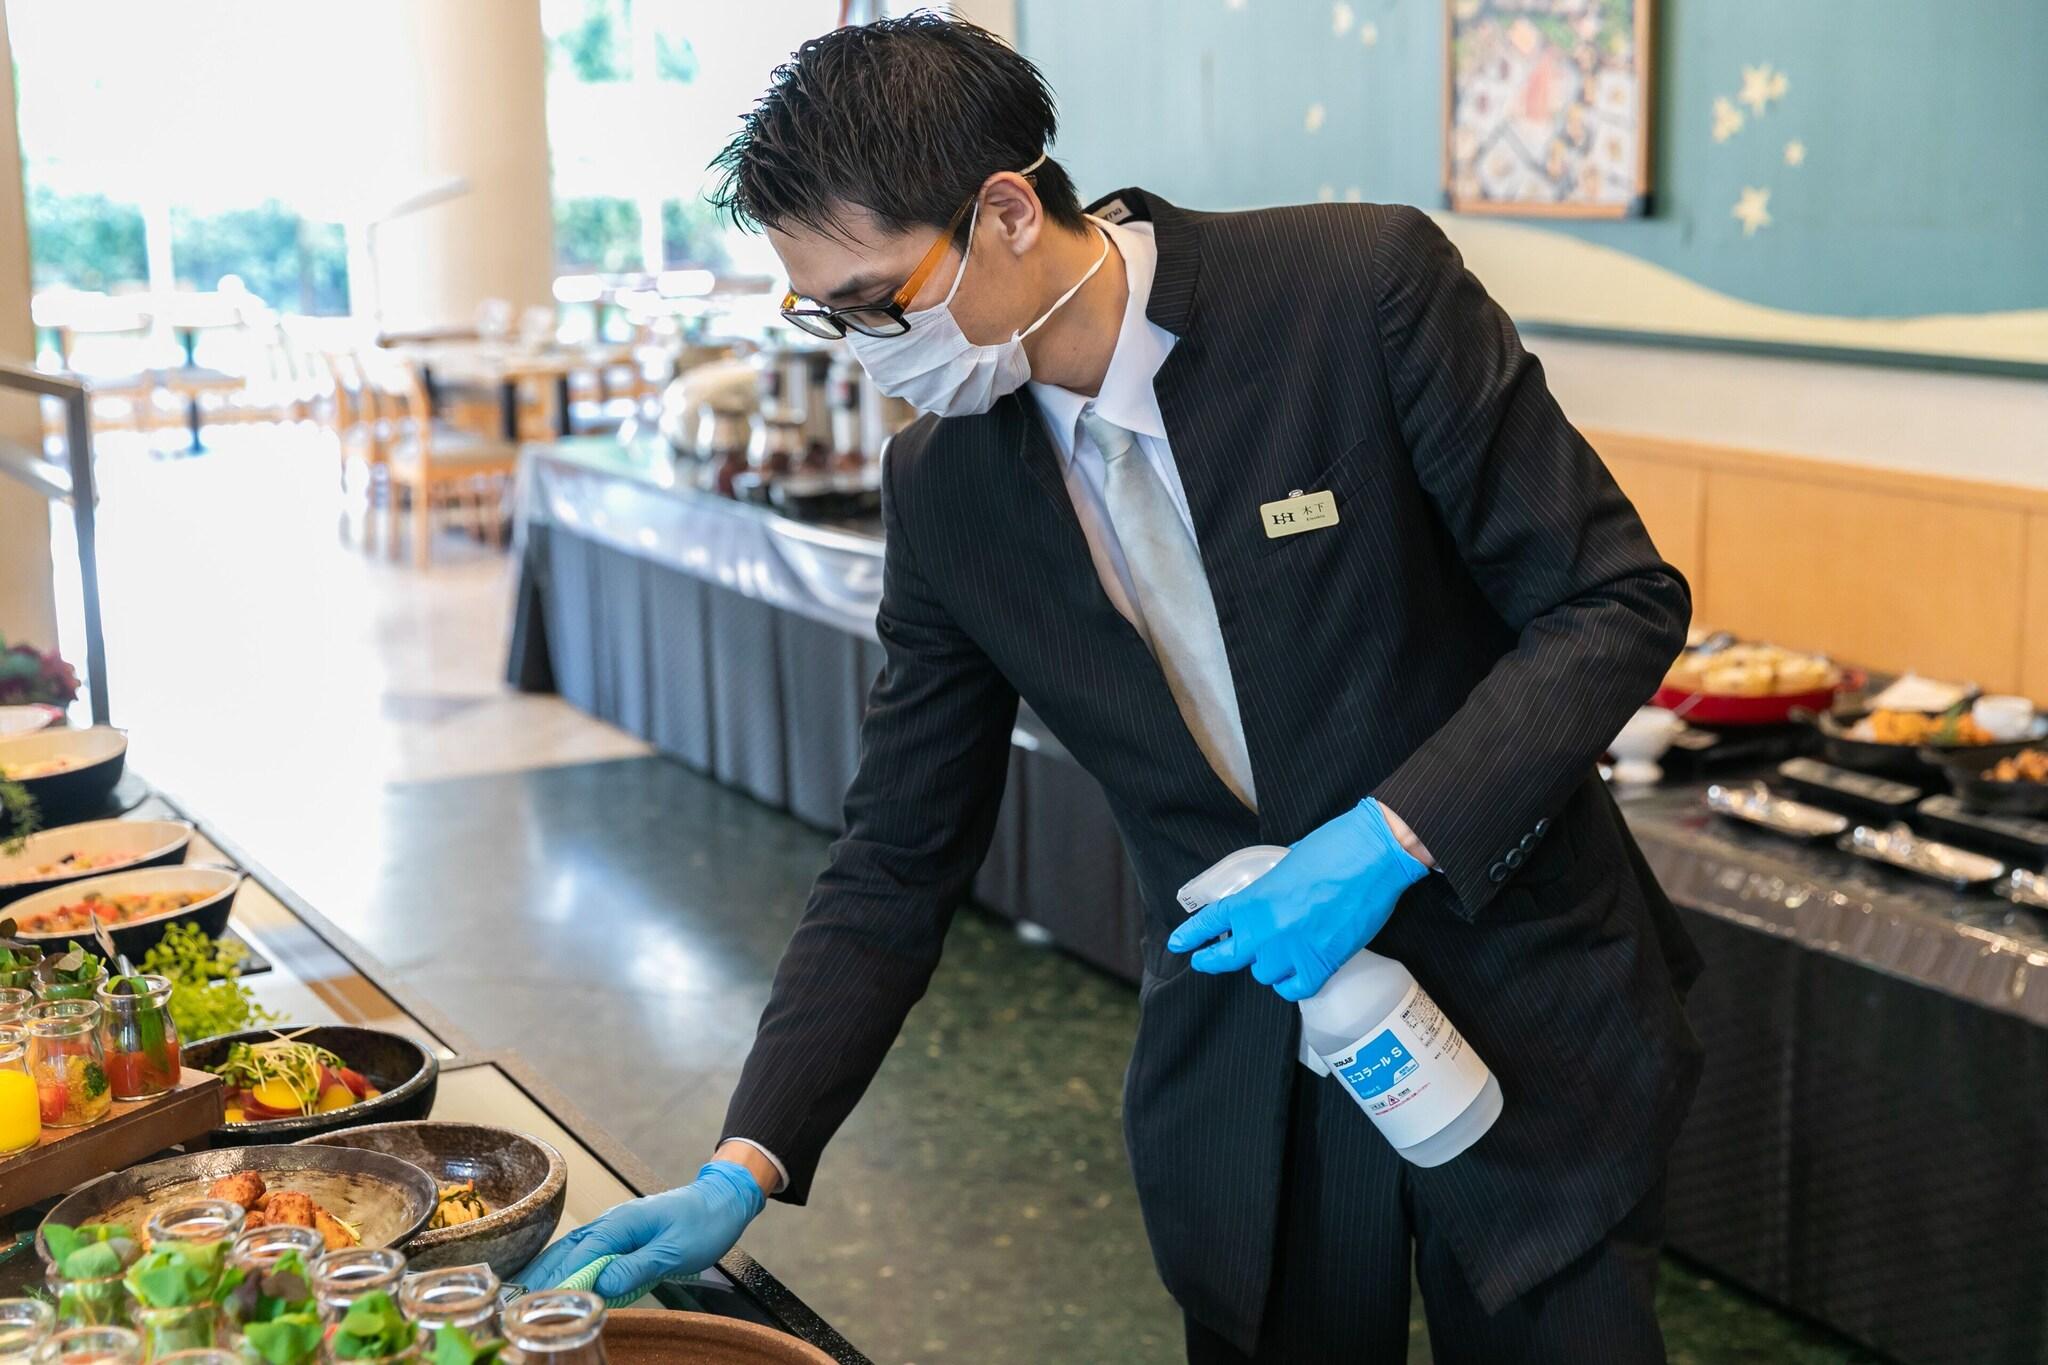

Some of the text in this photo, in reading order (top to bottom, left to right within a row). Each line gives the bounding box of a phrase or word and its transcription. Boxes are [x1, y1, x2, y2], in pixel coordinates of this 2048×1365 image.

[1182, 896, 1198, 910] OFF
[1347, 1056, 1391, 1084] エコラール
[1391, 1046, 1403, 1058] S
